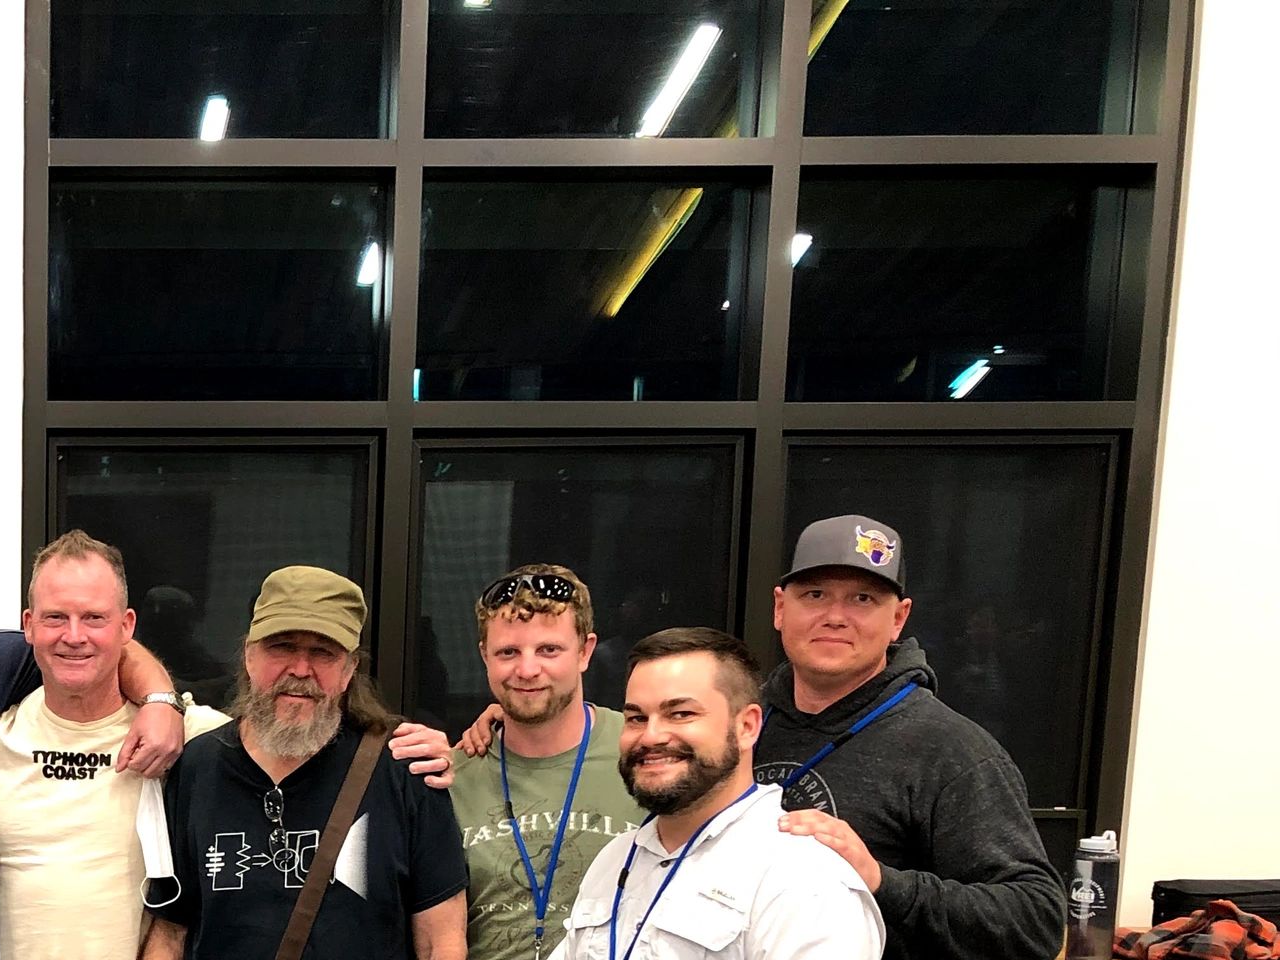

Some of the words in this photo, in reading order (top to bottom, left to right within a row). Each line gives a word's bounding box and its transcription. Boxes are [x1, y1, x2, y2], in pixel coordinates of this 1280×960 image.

[32, 750, 112, 767] TYPHOON
[42, 764, 98, 780] COAST
[798, 774, 829, 811] BRAN
